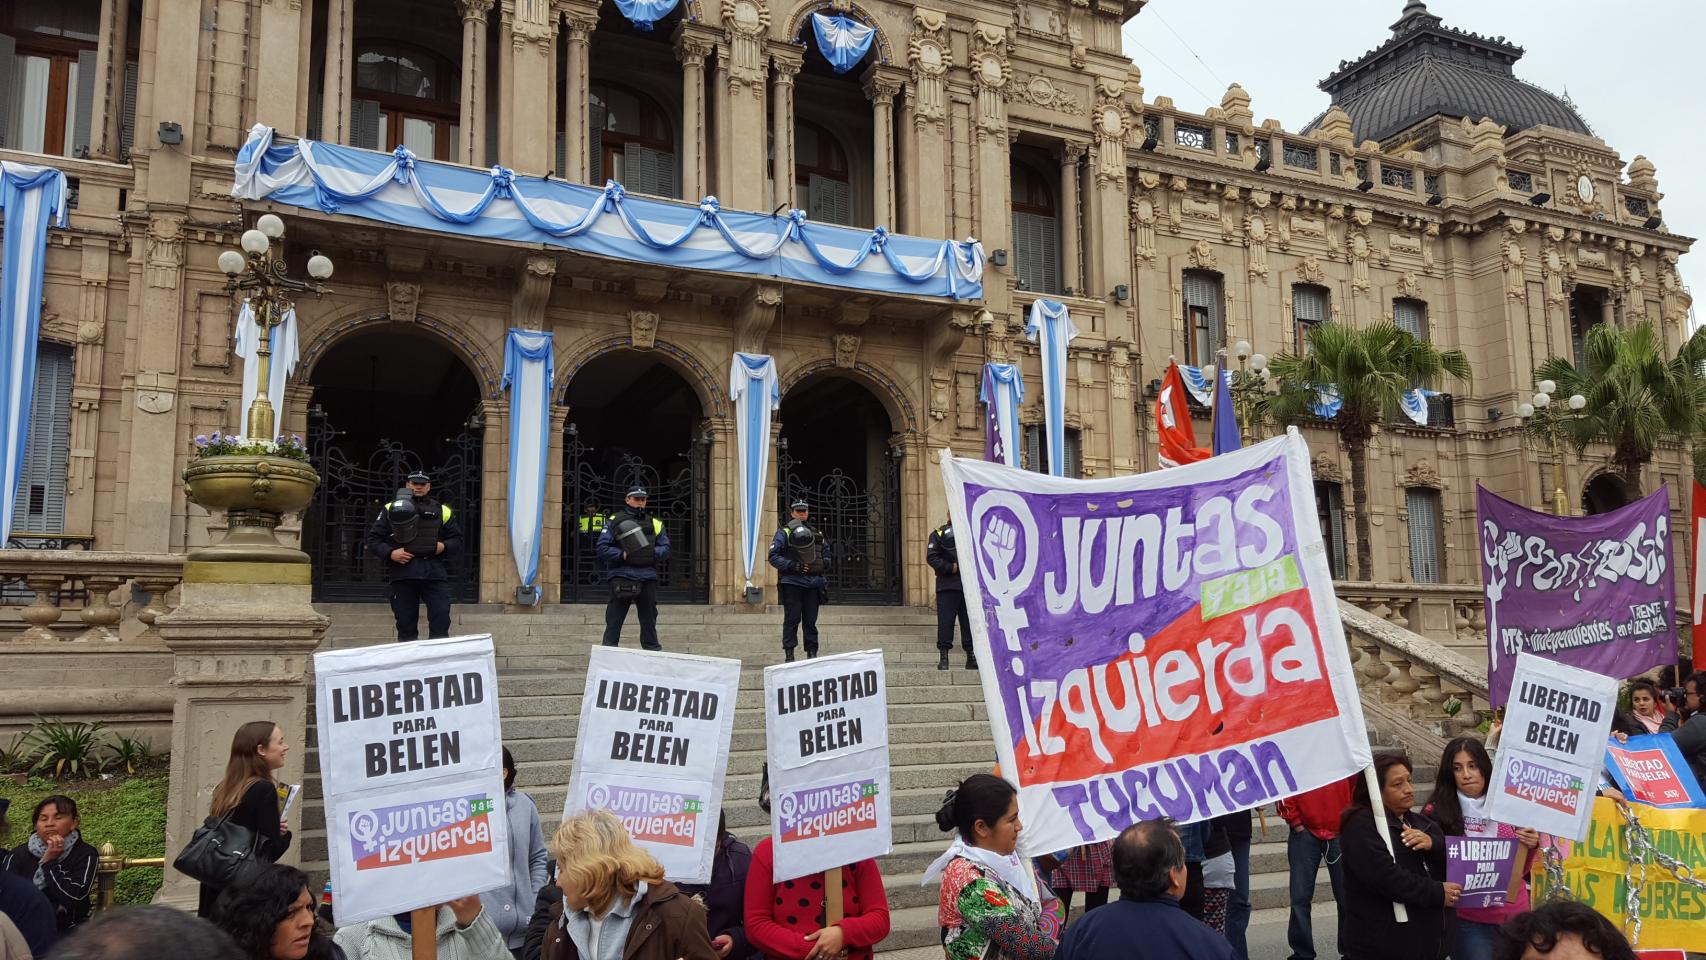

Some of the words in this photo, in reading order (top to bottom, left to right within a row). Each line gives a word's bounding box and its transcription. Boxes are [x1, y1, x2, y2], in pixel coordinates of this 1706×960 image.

[1502, 628, 1523, 655] PTS
[1530, 619, 1614, 654] independientes
[332, 672, 484, 724] LIBERTAD
[596, 679, 719, 721] LIBERTAD
[777, 670, 878, 715] LIBERTAD
[1011, 607, 1321, 765] izquierda
[1518, 681, 1601, 723] LIBERTAD
[392, 716, 437, 735] PARA
[638, 718, 674, 733] PARA
[817, 707, 846, 722] PARA
[1545, 715, 1570, 728] PARA
[364, 730, 461, 779] BELEN
[610, 731, 690, 767] BELEN
[799, 717, 863, 758] BELEN
[1525, 721, 1580, 755] BELEN
[1516, 778, 1577, 809] izquierda
[620, 815, 695, 839] quierda
[797, 801, 875, 837] izquierda
[379, 820, 489, 865] izquierda
[1463, 872, 1500, 891] BELEN
[1476, 862, 1496, 873] PARA
